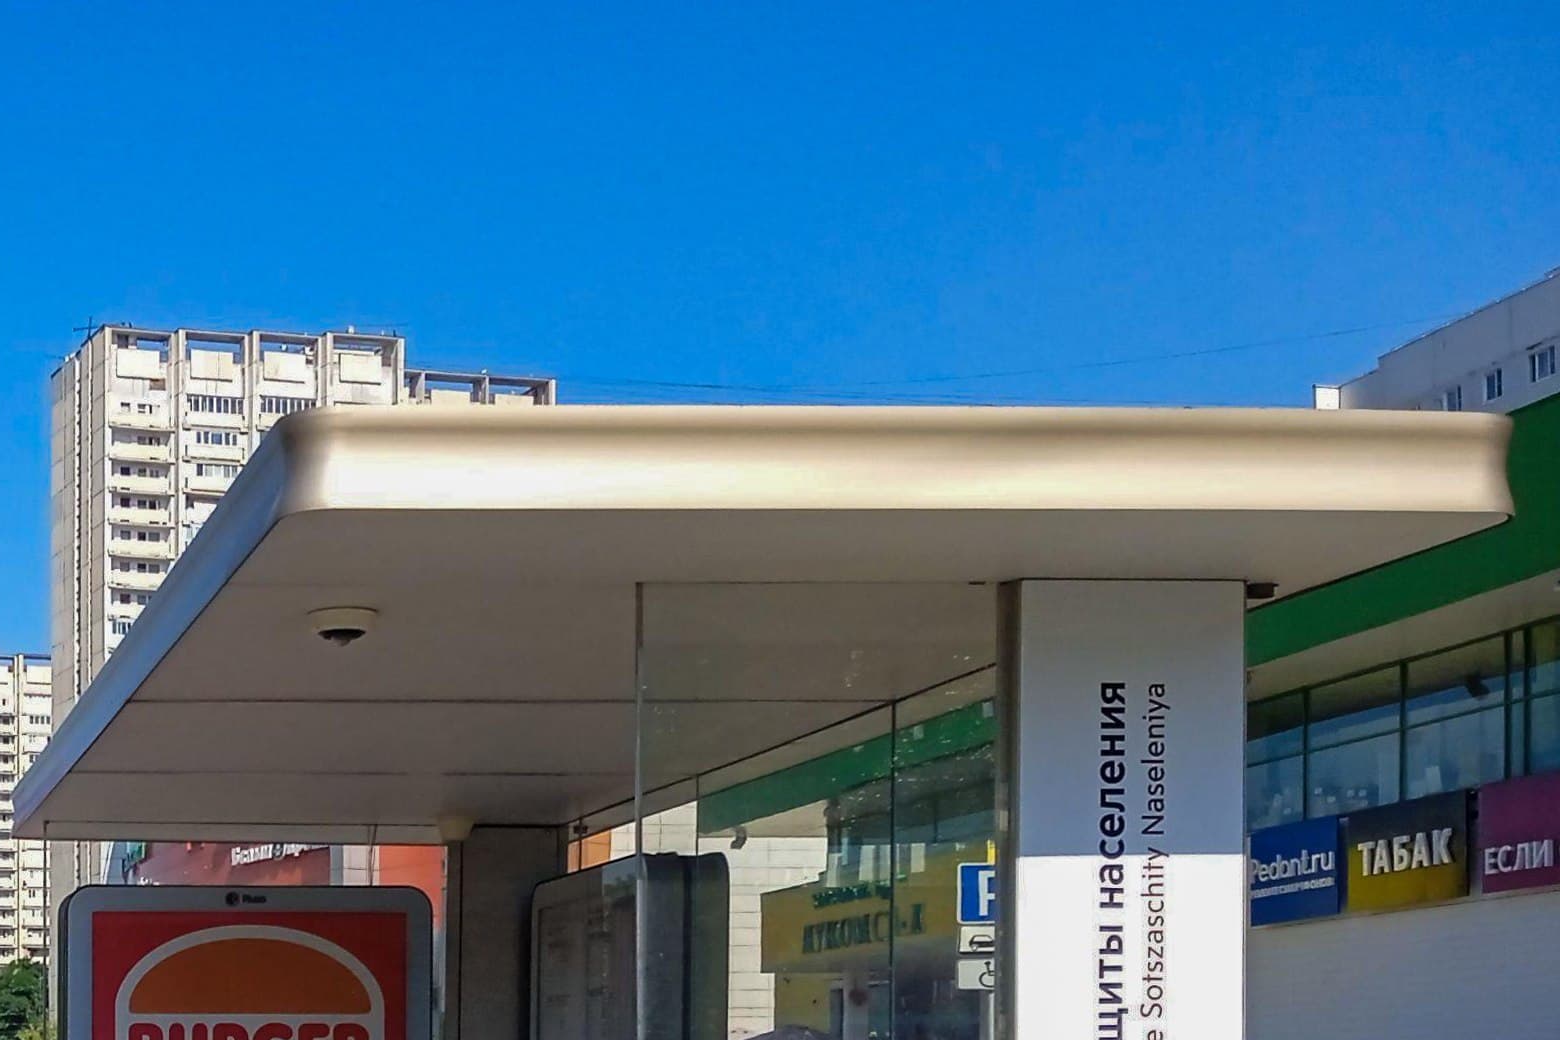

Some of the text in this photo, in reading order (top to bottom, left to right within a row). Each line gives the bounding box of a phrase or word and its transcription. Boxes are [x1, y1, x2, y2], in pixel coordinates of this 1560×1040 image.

[1098, 681, 1126, 909] населения
[1140, 682, 1170, 835] Naseleniya
[1358, 827, 1453, 876] ТАБАК
[1484, 839, 1554, 875] ЕСЛИ
[1140, 846, 1169, 1018] Sotszaschity
